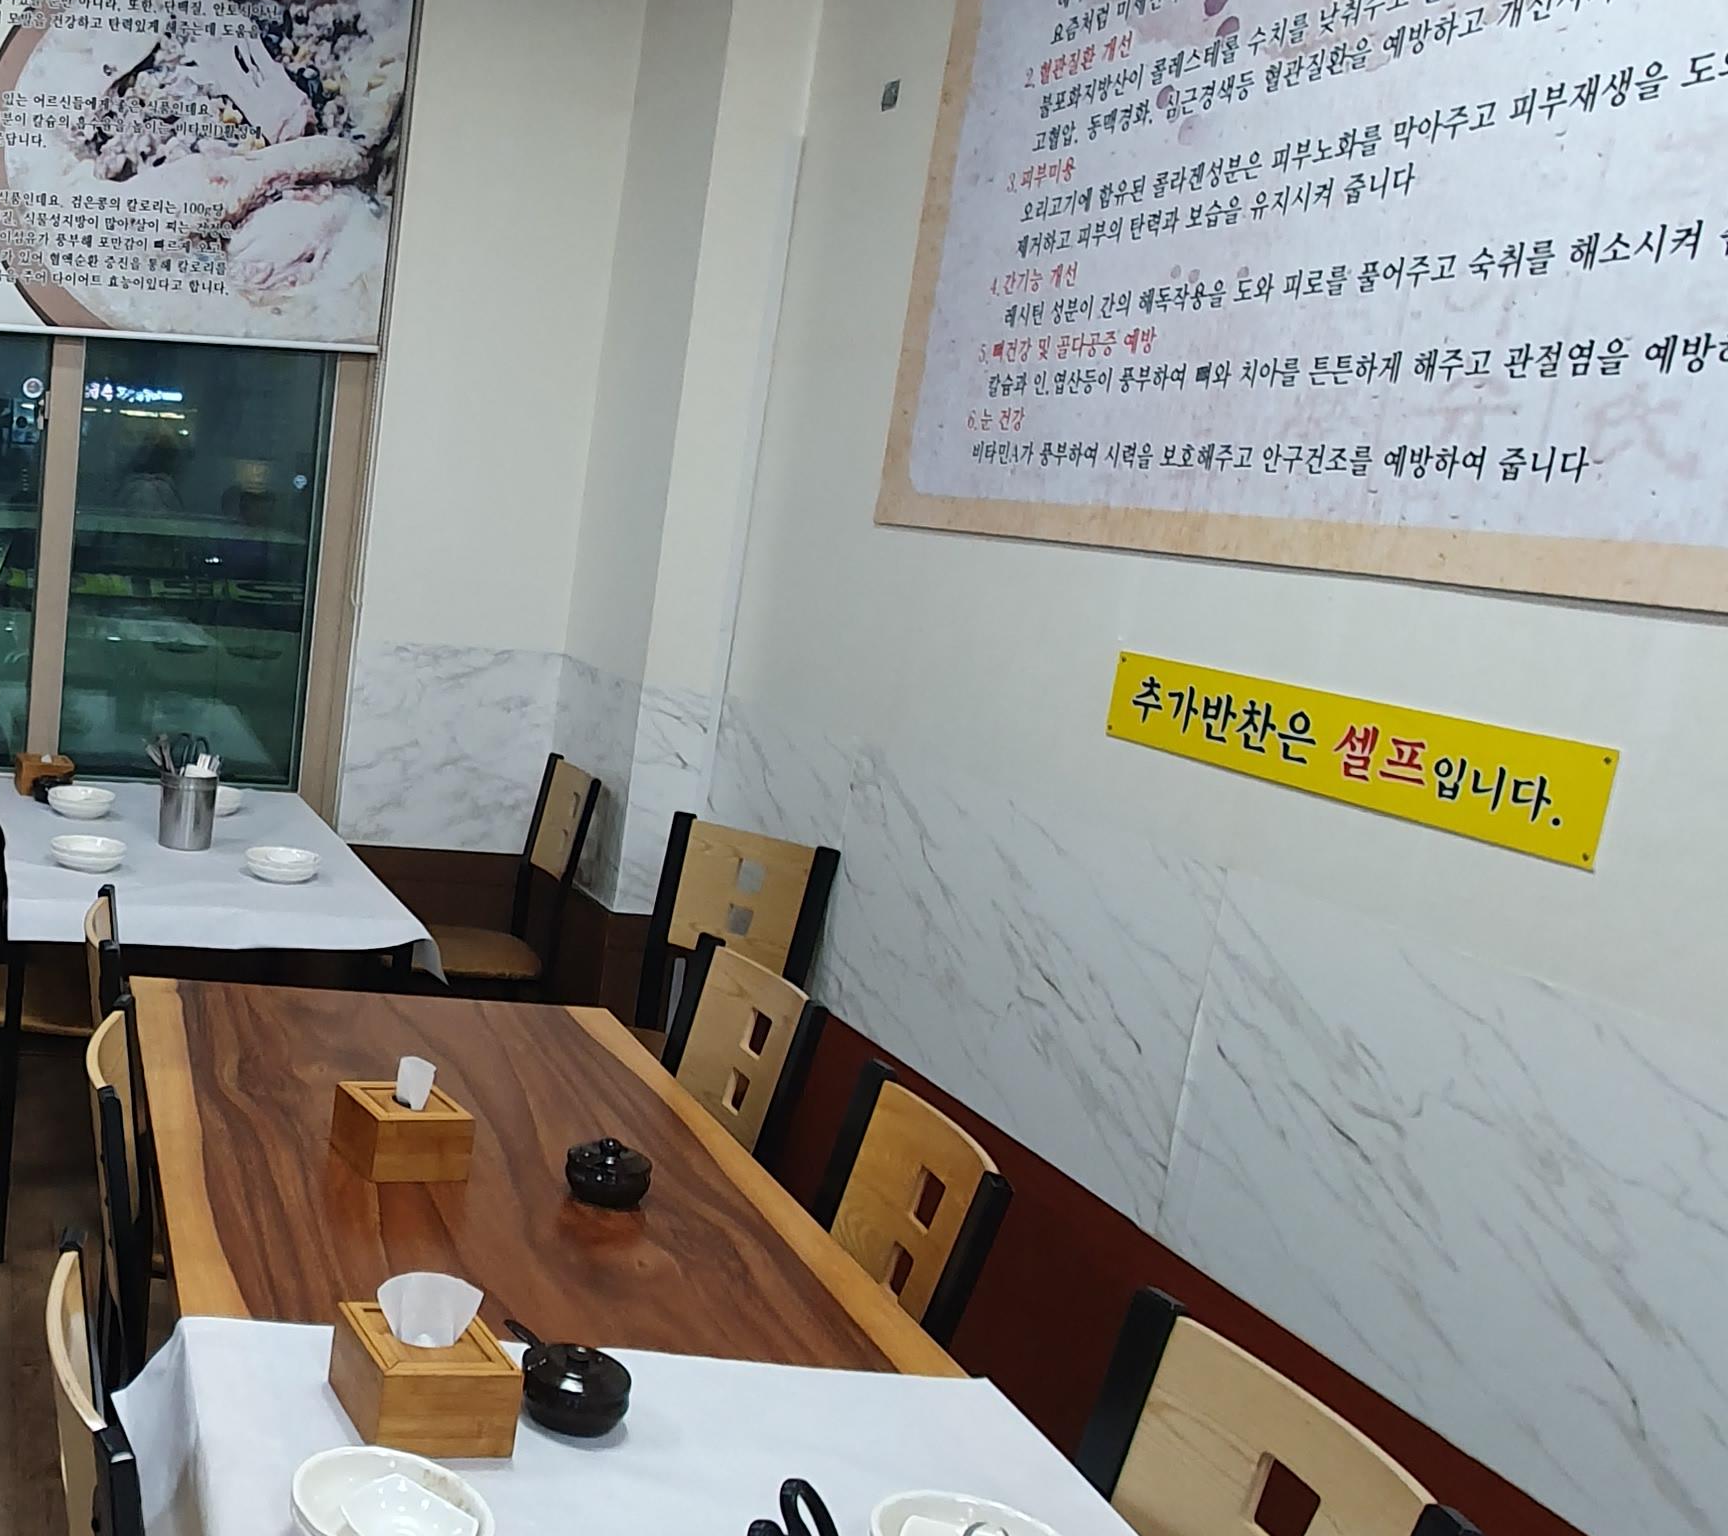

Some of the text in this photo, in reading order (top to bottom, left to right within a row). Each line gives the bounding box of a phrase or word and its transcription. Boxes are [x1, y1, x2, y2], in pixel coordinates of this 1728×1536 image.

[53, 14, 103, 30] 건강하고
[1050, 2, 1110, 44] 요즘처럼
[1040, 64, 1144, 118] 불포화지방산이
[1150, 34, 1239, 86] 콜레스테롤
[1248, 12, 1308, 56] 수치를
[1103, 30, 1132, 60] 개선
[1165, 70, 1254, 123] 심근경색등
[1266, 34, 1374, 92] 혈관질환을
[1383, 8, 1488, 62] 예방하고
[3, 93, 28, 107] 있는
[1020, 187, 1092, 222] 오리고기에
[1100, 175, 1146, 209] 함유된
[1272, 124, 1382, 169] 피부노화를
[1394, 102, 1496, 149] 막아주고
[1509, 61, 1668, 125] 피부재생을
[1680, 52, 1728, 87] 도
[1015, 162, 1416, 259] 제거하고 피부의 탄력과 보습을 유지시켜 줍니다
[52, 271, 102, 287] 다이어트
[1051, 294, 1094, 324] 성분이
[1098, 290, 1132, 318] 간의
[1139, 276, 1226, 314] 해독작용을
[1234, 273, 1274, 303] 도와
[1282, 264, 1347, 300] 피로를
[1357, 254, 1456, 292] 풀어주고
[1468, 240, 1556, 281] 숙취를
[1569, 220, 1703, 271] 해소시켜
[1052, 262, 1078, 287] 개선
[1039, 336, 1050, 360] 및
[1057, 330, 1120, 359] 골다공증
[1124, 326, 1156, 354] 예방
[989, 372, 1027, 398] 칼슘과
[1119, 363, 1186, 393] 풍부하여
[1240, 358, 1300, 388] 치아를
[1308, 350, 1402, 386] 튼튼하게
[1414, 348, 1492, 382] 해주고
[1504, 337, 1629, 378] 관절염을
[1000, 407, 1024, 431] 건강
[1040, 442, 1098, 468] 풍부하여
[1104, 442, 1154, 469] 시력을
[1160, 443, 1252, 472] 보호해주고
[1263, 444, 1372, 476] 안구건조를
[1384, 444, 1486, 480] 예방하여
[1498, 446, 1589, 484] 줍니다
[1132, 676, 1562, 826] 추가반찬은 셀프입니다.
